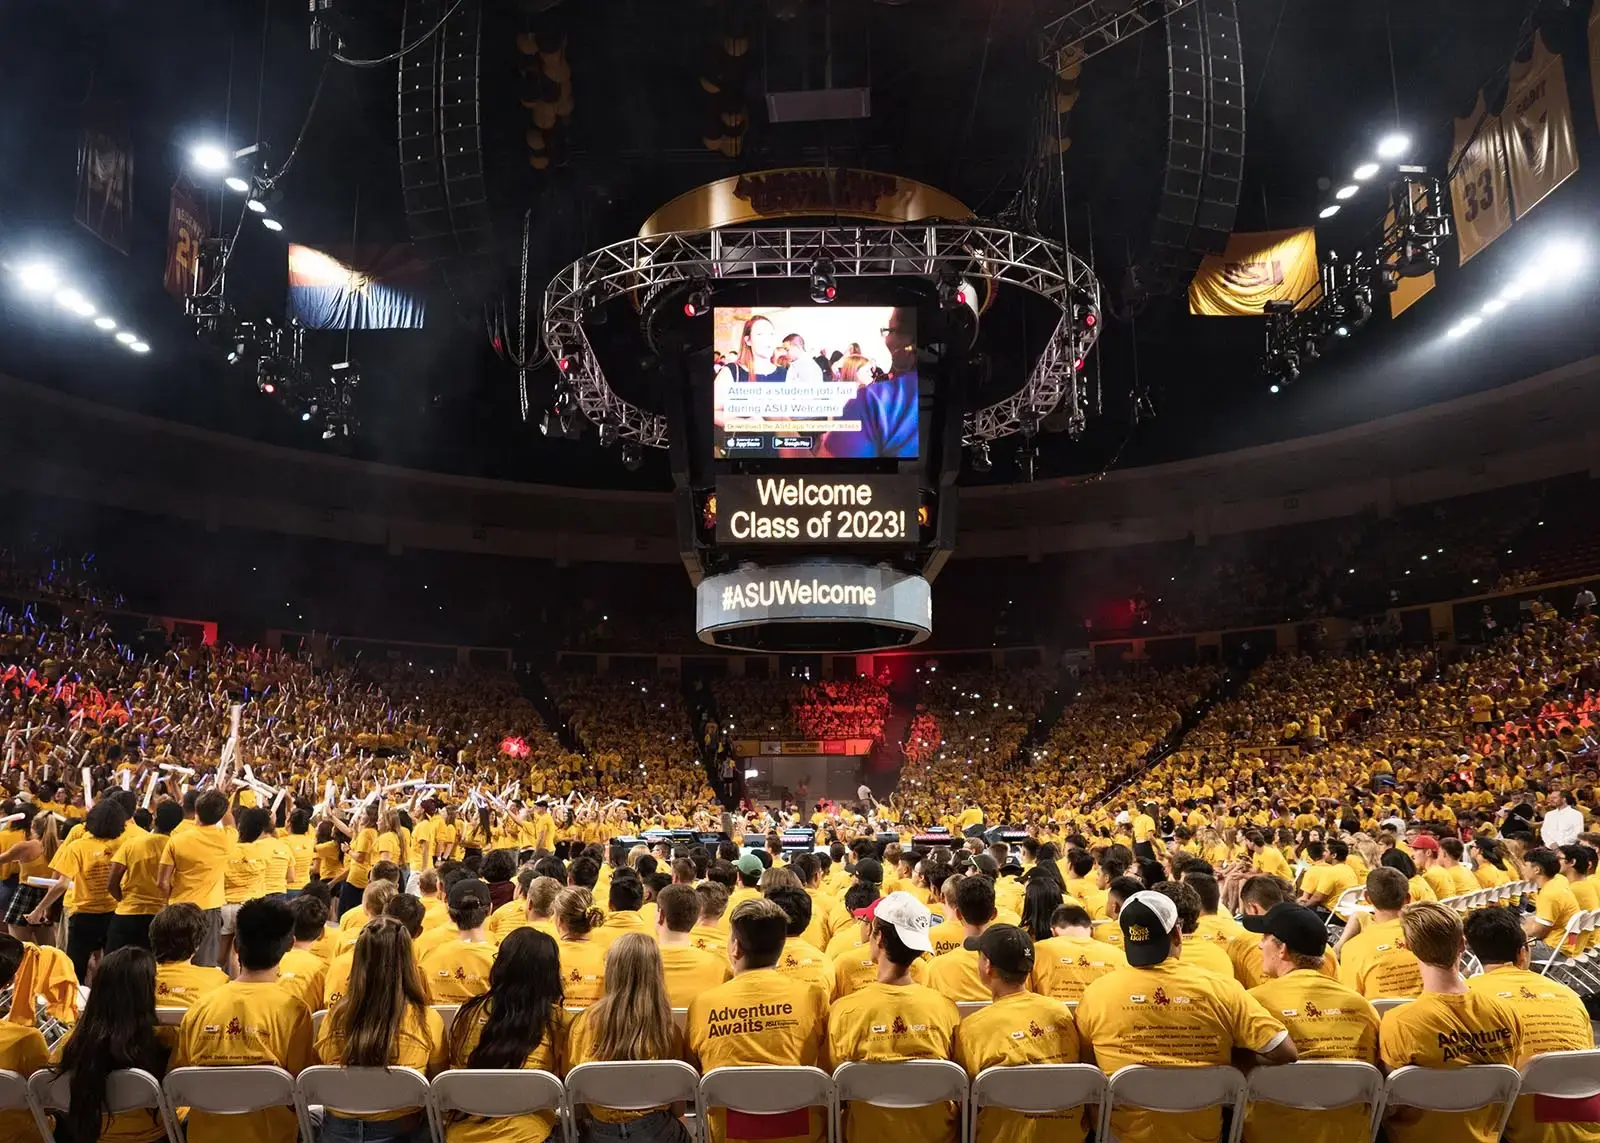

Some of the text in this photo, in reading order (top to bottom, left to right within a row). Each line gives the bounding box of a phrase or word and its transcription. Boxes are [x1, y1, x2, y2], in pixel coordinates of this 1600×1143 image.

[1464, 167, 1494, 223] 33
[728, 387, 762, 395] Attend
[774, 387, 813, 395] student
[816, 387, 834, 397] job
[836, 387, 853, 395] fair
[728, 404, 839, 413] during ASU Welcome
[756, 478, 873, 506] Welcome
[730, 511, 906, 539] Class of 2023!
[722, 579, 877, 612] #ASUWelcome
[707, 1003, 793, 1024] Adventure
[708, 1018, 764, 1039] Awaits
